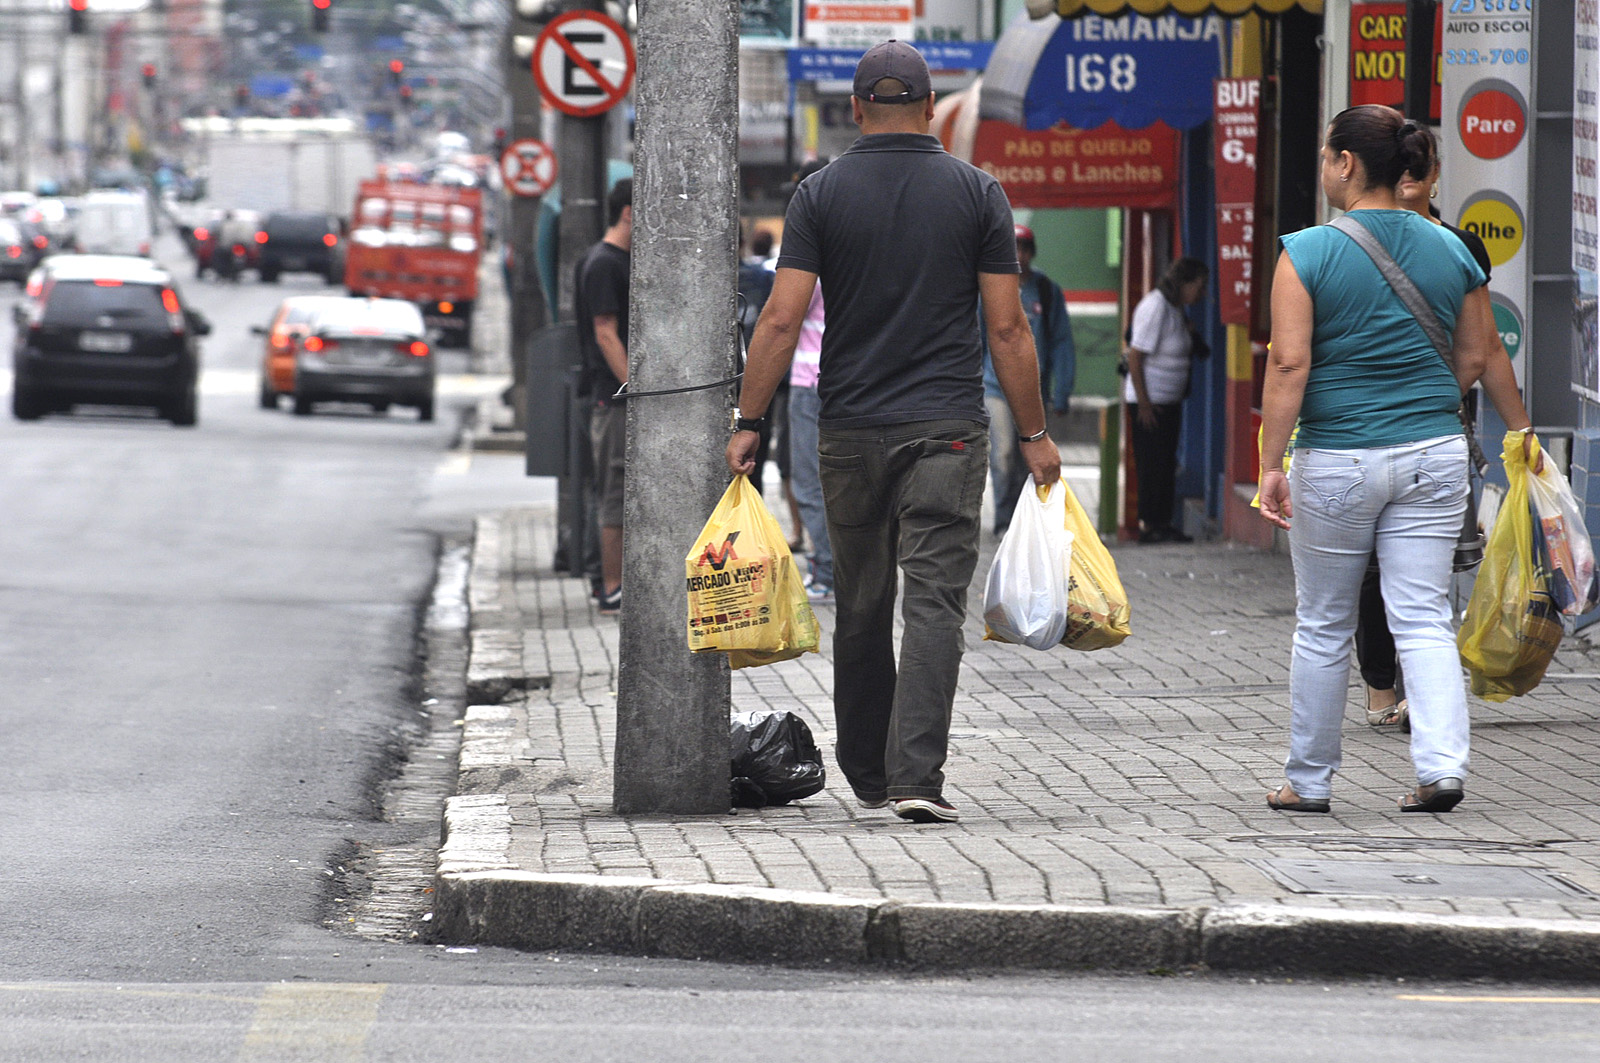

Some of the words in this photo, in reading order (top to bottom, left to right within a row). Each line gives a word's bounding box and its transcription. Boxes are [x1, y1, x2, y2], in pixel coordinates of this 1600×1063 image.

[1359, 15, 1407, 40] CAR
[1447, 21, 1480, 34] AUTO
[1066, 53, 1137, 92] 168
[1466, 115, 1517, 134] Pare
[1004, 138, 1045, 158] PÃO
[1051, 139, 1075, 157] DE
[1080, 137, 1152, 155] QUEIJO
[1053, 165, 1067, 183] e
[1072, 160, 1164, 183] Lanches
[1465, 221, 1516, 240] Olhe
